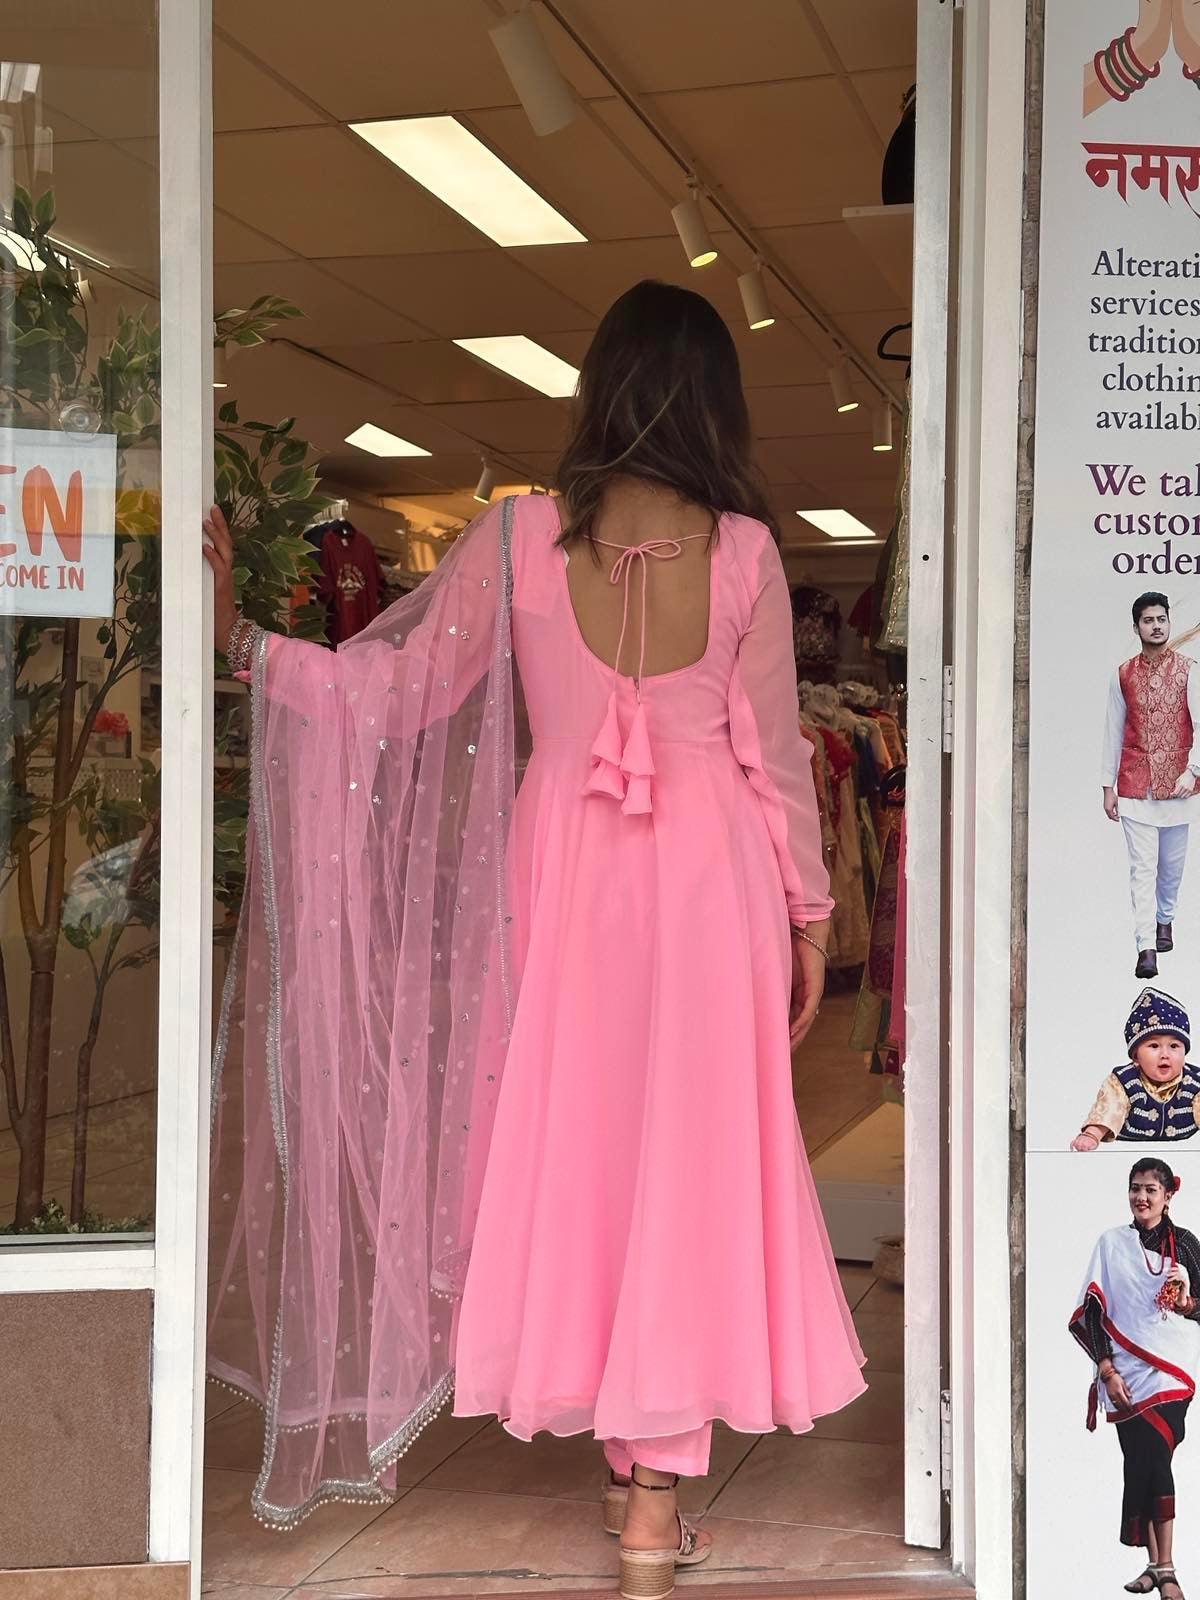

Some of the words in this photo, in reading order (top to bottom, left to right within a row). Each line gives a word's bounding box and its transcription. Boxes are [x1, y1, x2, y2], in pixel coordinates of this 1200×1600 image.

[1091, 248, 1200, 278] Alterati
[1090, 290, 1200, 316] services
[1096, 401, 1200, 430] availab
[1085, 463, 1146, 496] We
[57, 565, 84, 591] IN
